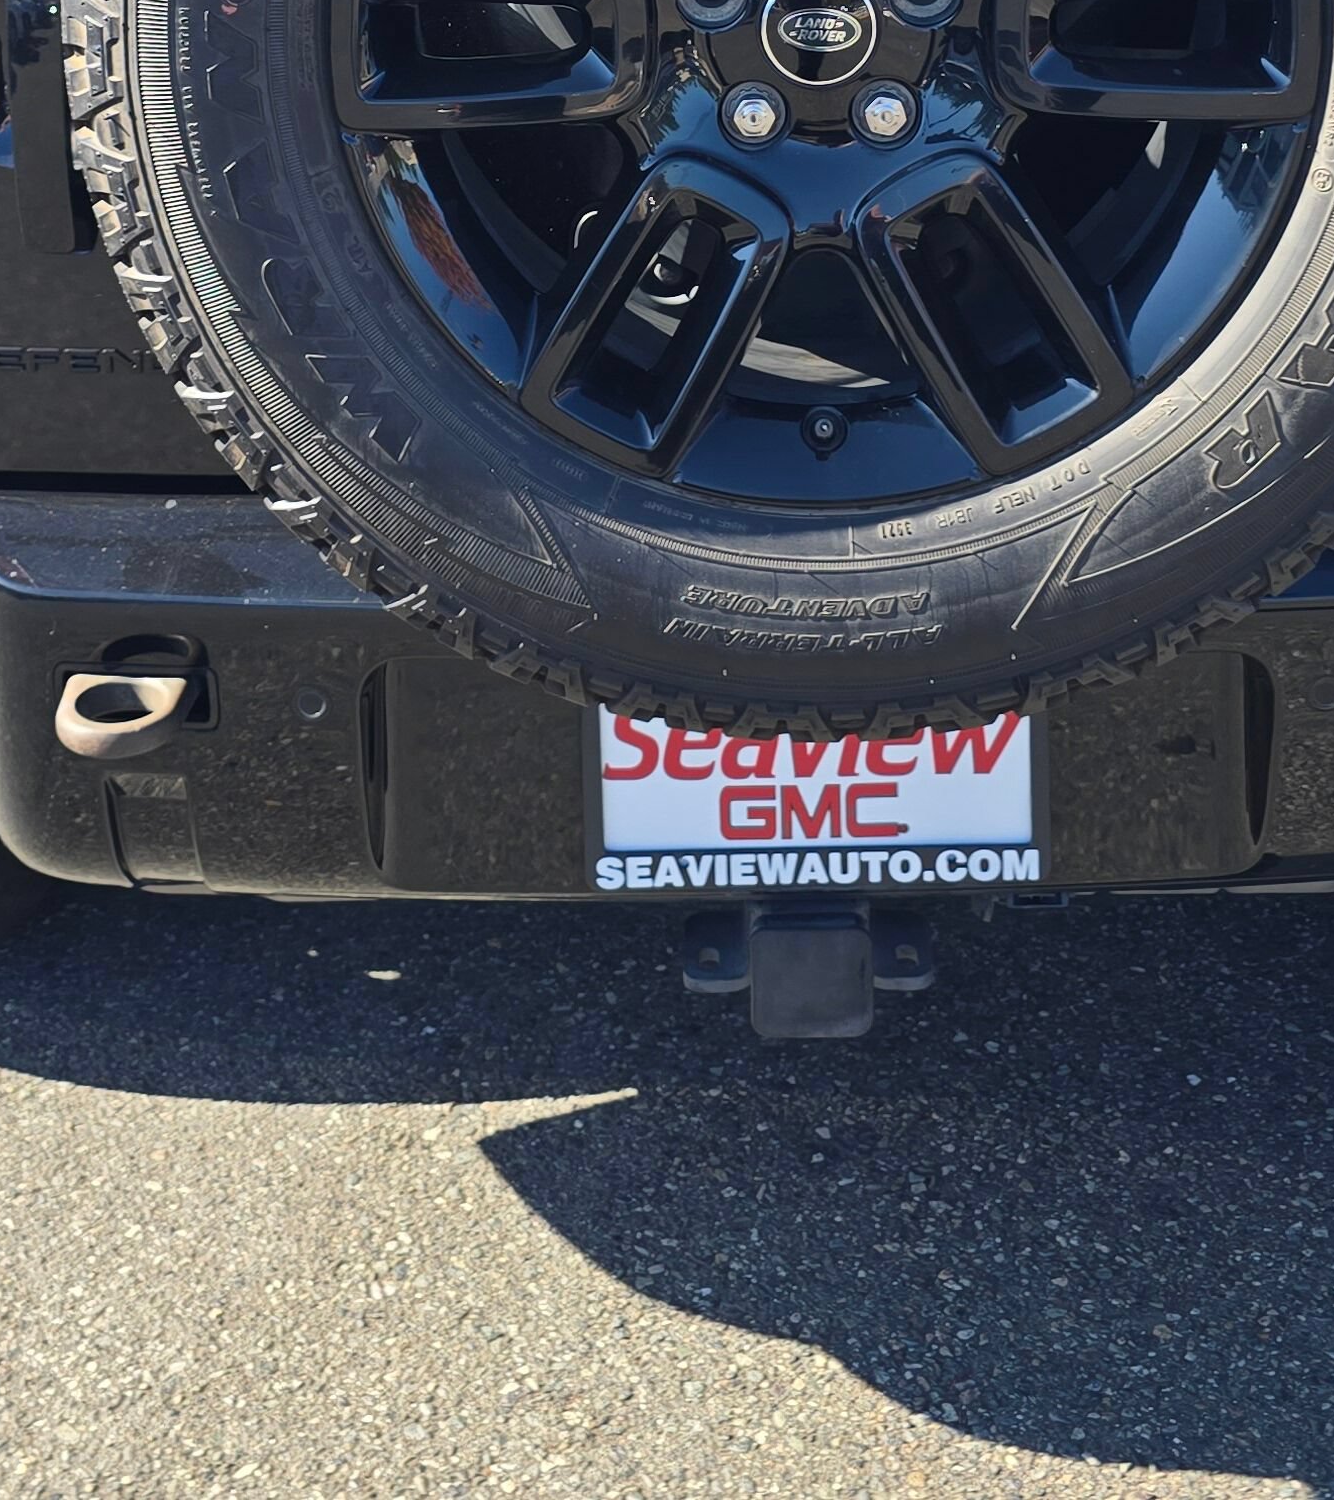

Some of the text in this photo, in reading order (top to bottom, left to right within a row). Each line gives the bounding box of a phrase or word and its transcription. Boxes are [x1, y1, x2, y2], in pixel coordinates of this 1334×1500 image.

[795, 17, 838, 30] LAND
[797, 29, 847, 42] ROVER
[1051, 458, 1093, 492] DOT
[680, 584, 932, 621] ADVENTURE
[662, 616, 947, 652] ALL-TERRAIN
[602, 710, 1021, 781] Seaview
[719, 781, 909, 841] GMC
[595, 847, 1041, 891] SEAVIEWAUTO.COM
